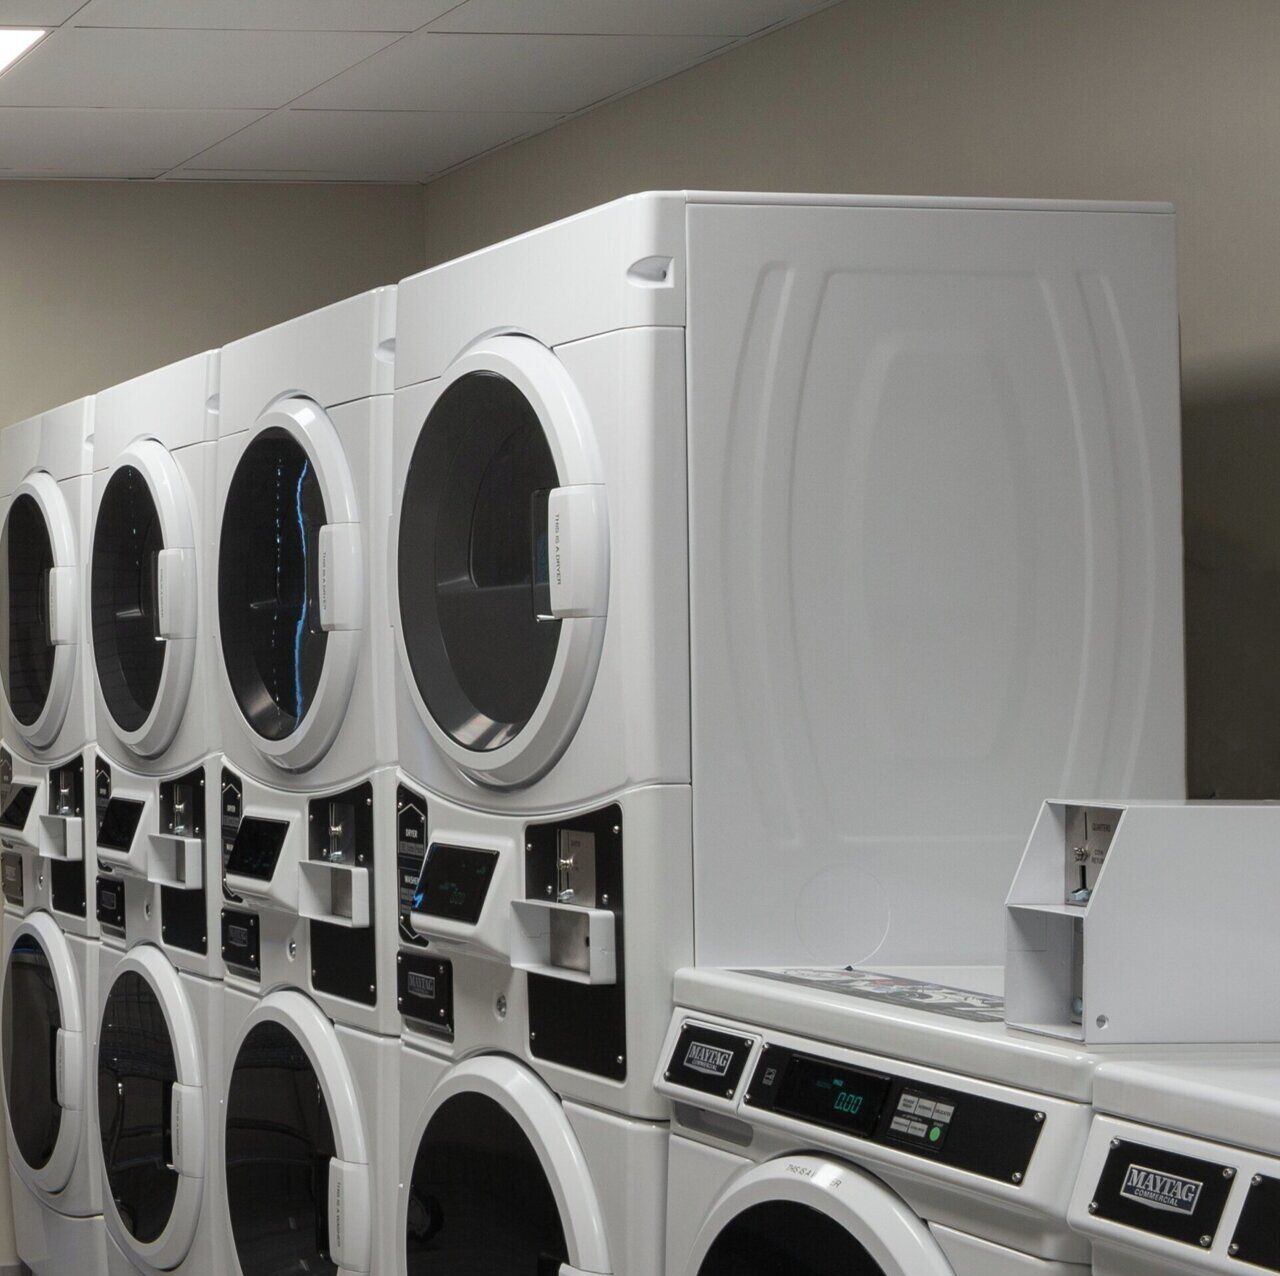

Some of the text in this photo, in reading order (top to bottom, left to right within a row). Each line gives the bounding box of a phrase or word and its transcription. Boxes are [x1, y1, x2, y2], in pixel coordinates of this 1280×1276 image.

[688, 1045, 729, 1067] MAYTAG
[833, 1092, 864, 1114] 0.00
[1127, 1168, 1196, 1202] MAYTAG
[1134, 1188, 1178, 1207] COMMERCIAL
